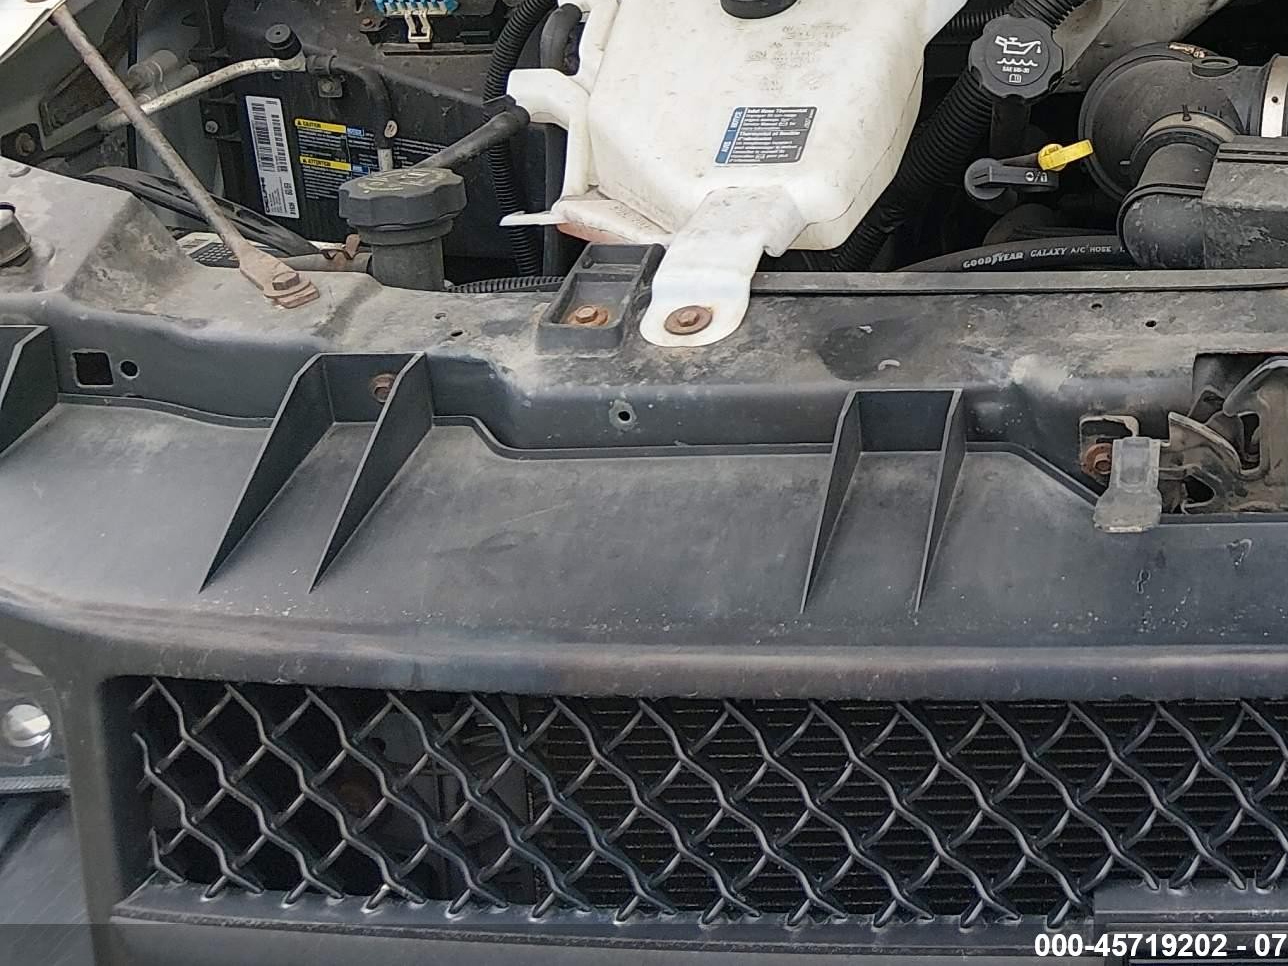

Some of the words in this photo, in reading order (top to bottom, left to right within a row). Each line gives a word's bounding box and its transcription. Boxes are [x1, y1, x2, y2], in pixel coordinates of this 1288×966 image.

[962, 251, 1024, 269] GOODYEAR
[1030, 247, 1067, 258] GALAXY
[1070, 246, 1086, 254] A/C
[1089, 245, 1112, 253] HOSE
